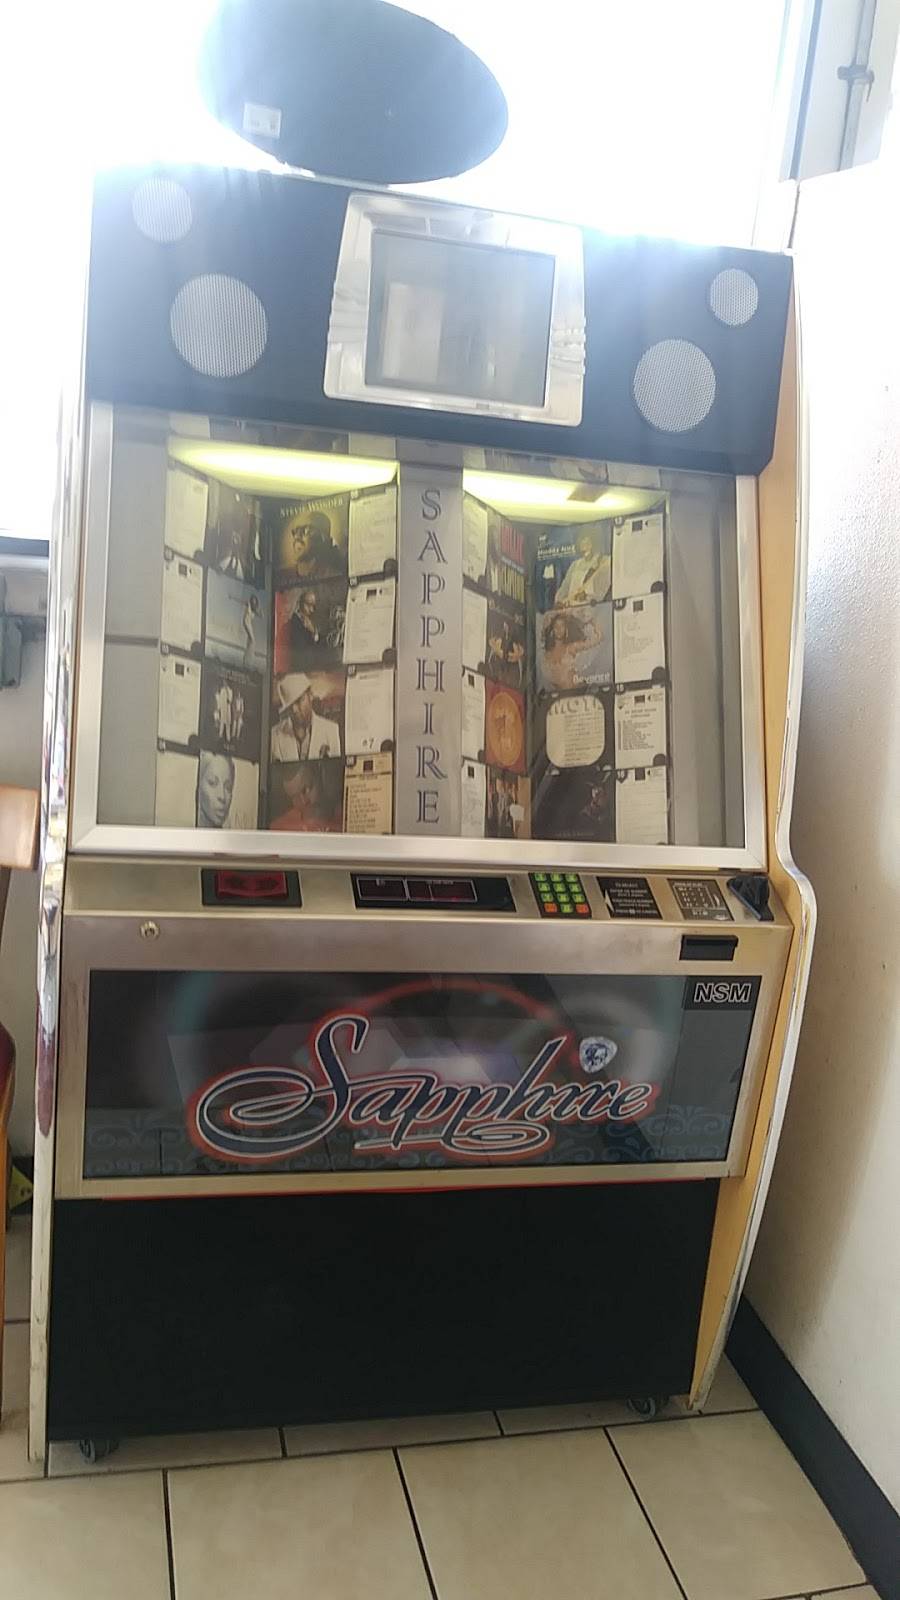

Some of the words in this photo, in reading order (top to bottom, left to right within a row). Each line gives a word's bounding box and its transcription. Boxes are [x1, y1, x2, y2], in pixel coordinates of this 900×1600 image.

[416, 486, 449, 825] SAPPHIRE
[693, 982, 752, 1003] NSM
[197, 1014, 655, 1158] Sapphire
